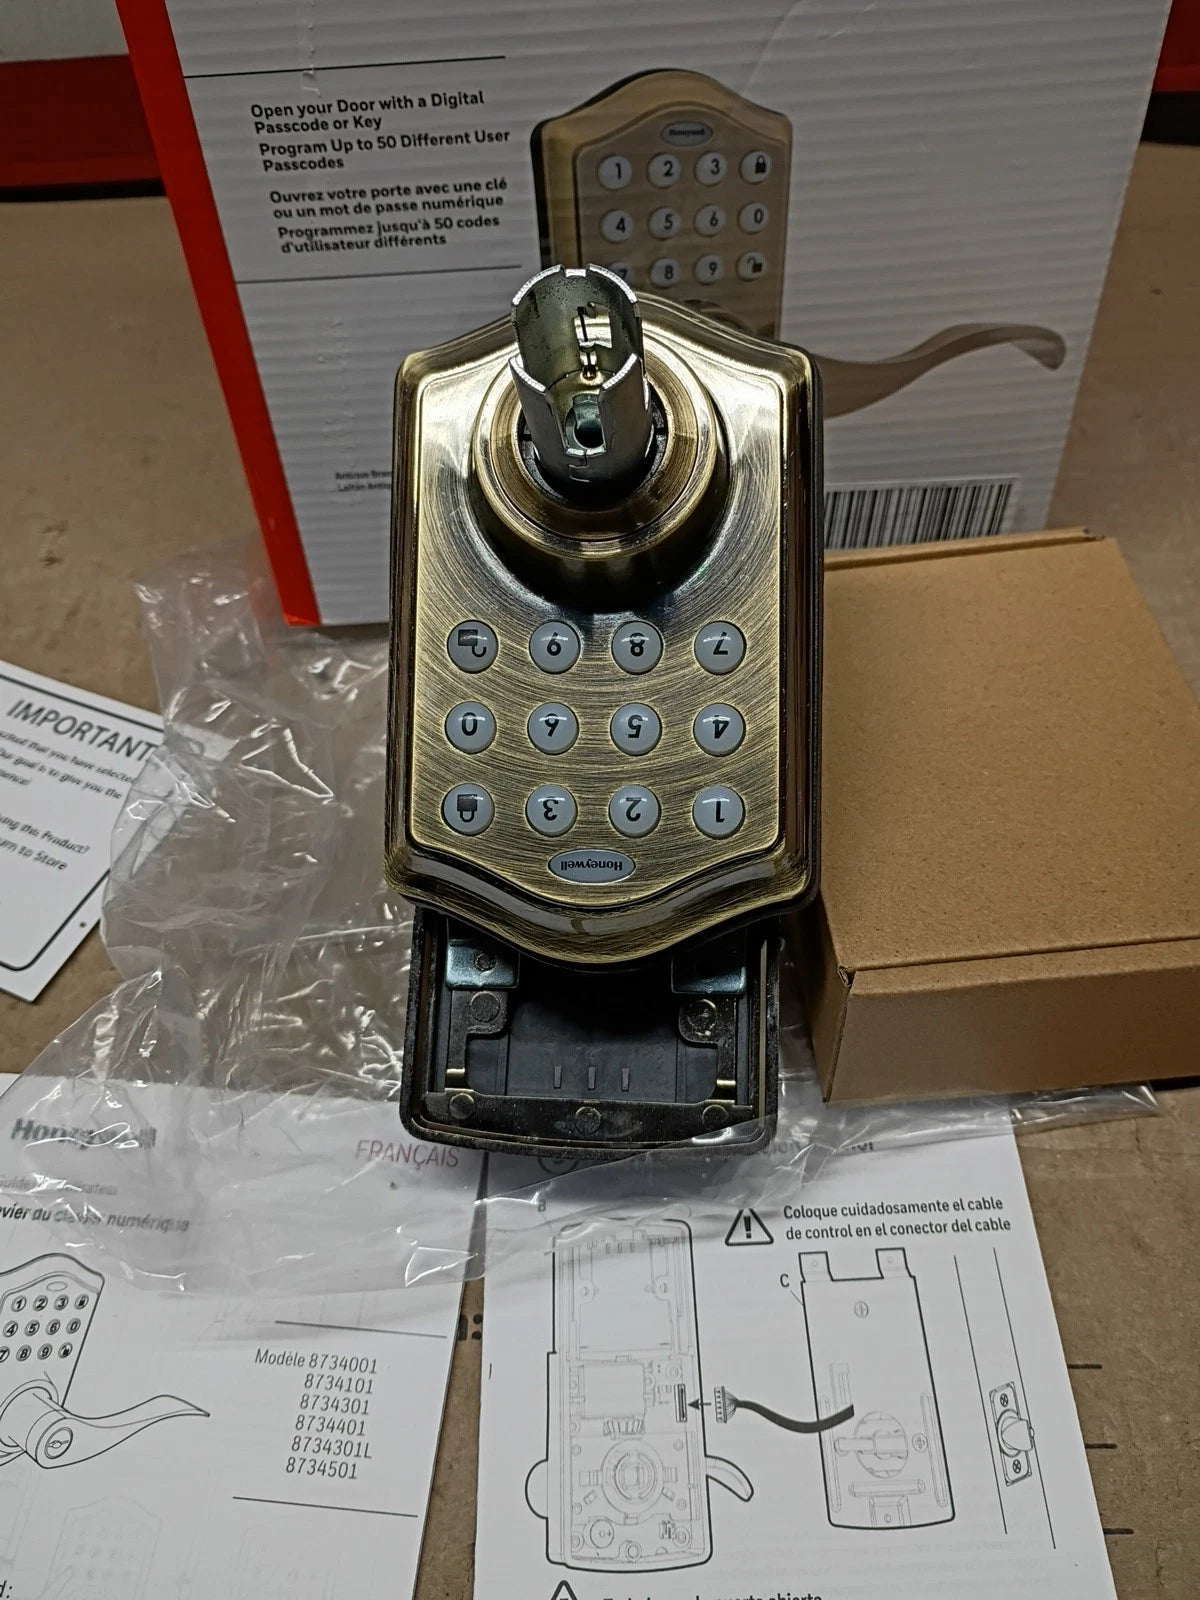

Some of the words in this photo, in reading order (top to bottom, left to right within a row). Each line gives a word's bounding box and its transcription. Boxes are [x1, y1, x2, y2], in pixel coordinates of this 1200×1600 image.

[251, 104, 293, 119] Open
[297, 103, 333, 118] your
[337, 99, 375, 112] Door
[379, 96, 414, 110] with
[418, 97, 427, 108] a
[431, 90, 485, 109] Digital
[255, 118, 329, 134] Passcode
[333, 119, 349, 130] or
[353, 115, 382, 131] Key
[260, 142, 327, 158] Program
[330, 139, 353, 154] Up
[357, 139, 373, 150] to
[377, 135, 397, 149] 50
[400, 132, 471, 148] Different
[475, 129, 510, 143] User
[263, 157, 344, 172] Passcodes
[615, 163, 622, 180] 1
[663, 160, 673, 177] 2
[711, 158, 720, 175] 3
[270, 190, 324, 204] Ouvrez
[326, 187, 367, 200] votre
[371, 185, 411, 200] porte
[415, 184, 450, 195] avec
[453, 181, 481, 193] une
[485, 176, 508, 191] clé
[273, 209, 293, 219] ou
[296, 207, 316, 218] un
[319, 204, 350, 216] mot
[353, 202, 371, 214] de
[375, 201, 418, 216] passe
[422, 195, 504, 210] numérique
[278, 224, 373, 241] Programmez
[377, 219, 431, 238] jusqu'à
[434, 217, 453, 229] 50
[457, 216, 500, 229] codes
[616, 217, 626, 233] 4
[664, 214, 673, 230] 5
[709, 211, 718, 227] 6
[754, 209, 763, 224] 0
[281, 239, 370, 254] d'utilisateur
[374, 234, 447, 248] différents
[664, 265, 673, 280] 8
[709, 261, 717, 276] 9
[630, 632, 644, 657] 8
[712, 632, 729, 656] 7
[6, 699, 161, 762] IMPORTANT
[461, 712, 478, 736] 0
[545, 713, 560, 737] 6
[628, 714, 642, 739] 5
[712, 714, 730, 739] 4
[104, 788, 122, 799] the
[544, 797, 559, 820] 3
[626, 798, 641, 822] 2
[714, 800, 725, 823] 1
[34, 850, 68, 870] Store
[560, 859, 623, 872] Honeywell
[356, 1139, 458, 1169] FRANÇAIS
[32, 1207, 52, 1221] du
[783, 1205, 838, 1221] Coloque
[841, 1200, 950, 1217] cuidadosamente
[952, 1197, 966, 1211] el
[967, 1196, 1004, 1211] cable
[786, 1226, 802, 1240] de
[805, 1224, 853, 1239] control
[855, 1225, 872, 1237] en
[875, 1222, 888, 1236] el
[890, 1221, 947, 1236] conector
[951, 1218, 973, 1233] del
[975, 1217, 1011, 1232] cable
[780, 1273, 791, 1288] C
[6, 1322, 17, 1335] 4
[28, 1322, 38, 1334] 5
[20, 1348, 29, 1359] 8
[255, 1348, 305, 1367] Modèle
[309, 1353, 377, 1374] 8734001
[304, 1373, 373, 1395] 8734101
[300, 1393, 369, 1416] 8734301
[295, 1414, 365, 1437] 8734401
[291, 1435, 372, 1459] 8734301L
[286, 1457, 357, 1480] 8734501
